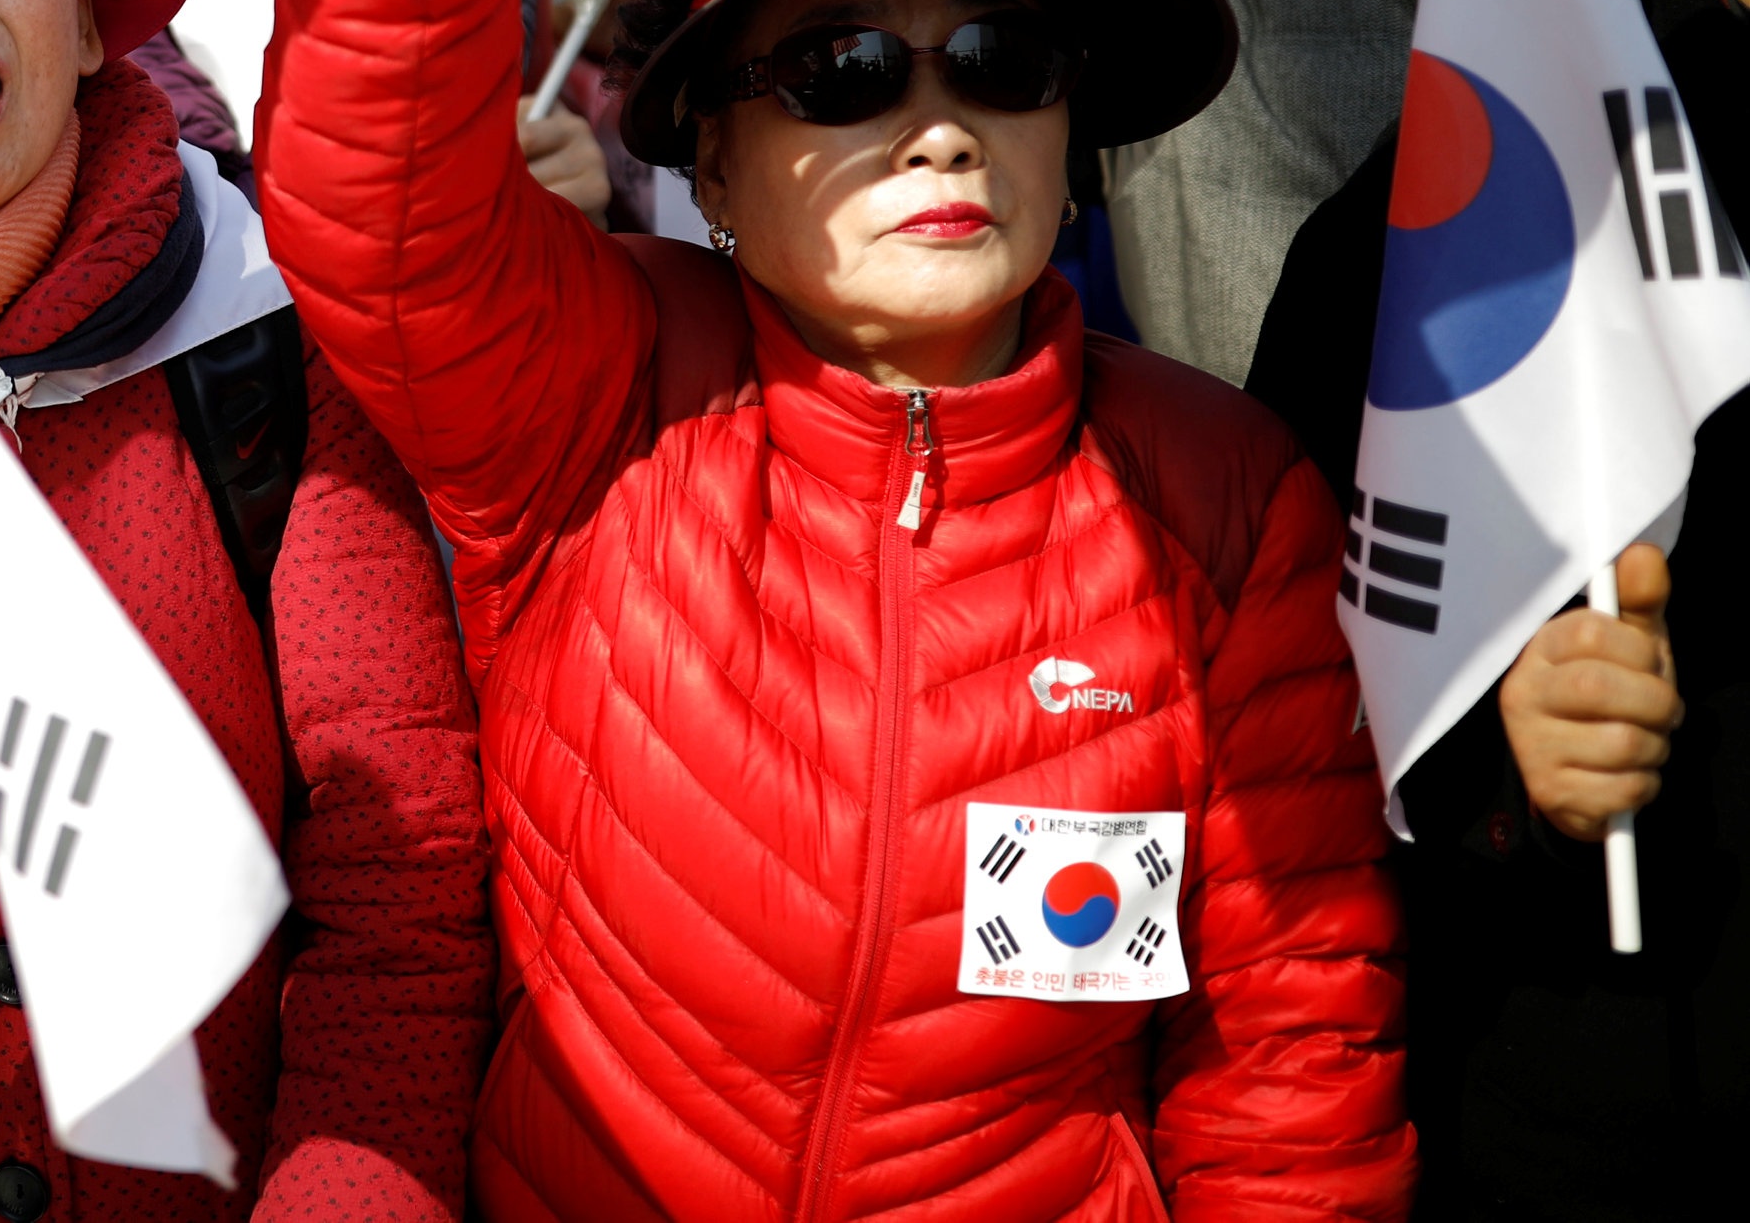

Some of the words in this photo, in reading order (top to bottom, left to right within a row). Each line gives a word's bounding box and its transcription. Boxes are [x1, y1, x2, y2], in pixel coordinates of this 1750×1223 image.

[1072, 688, 1134, 714] NEPA
[1032, 971, 1066, 993] 인민
[1073, 971, 1132, 992] 태극기는
